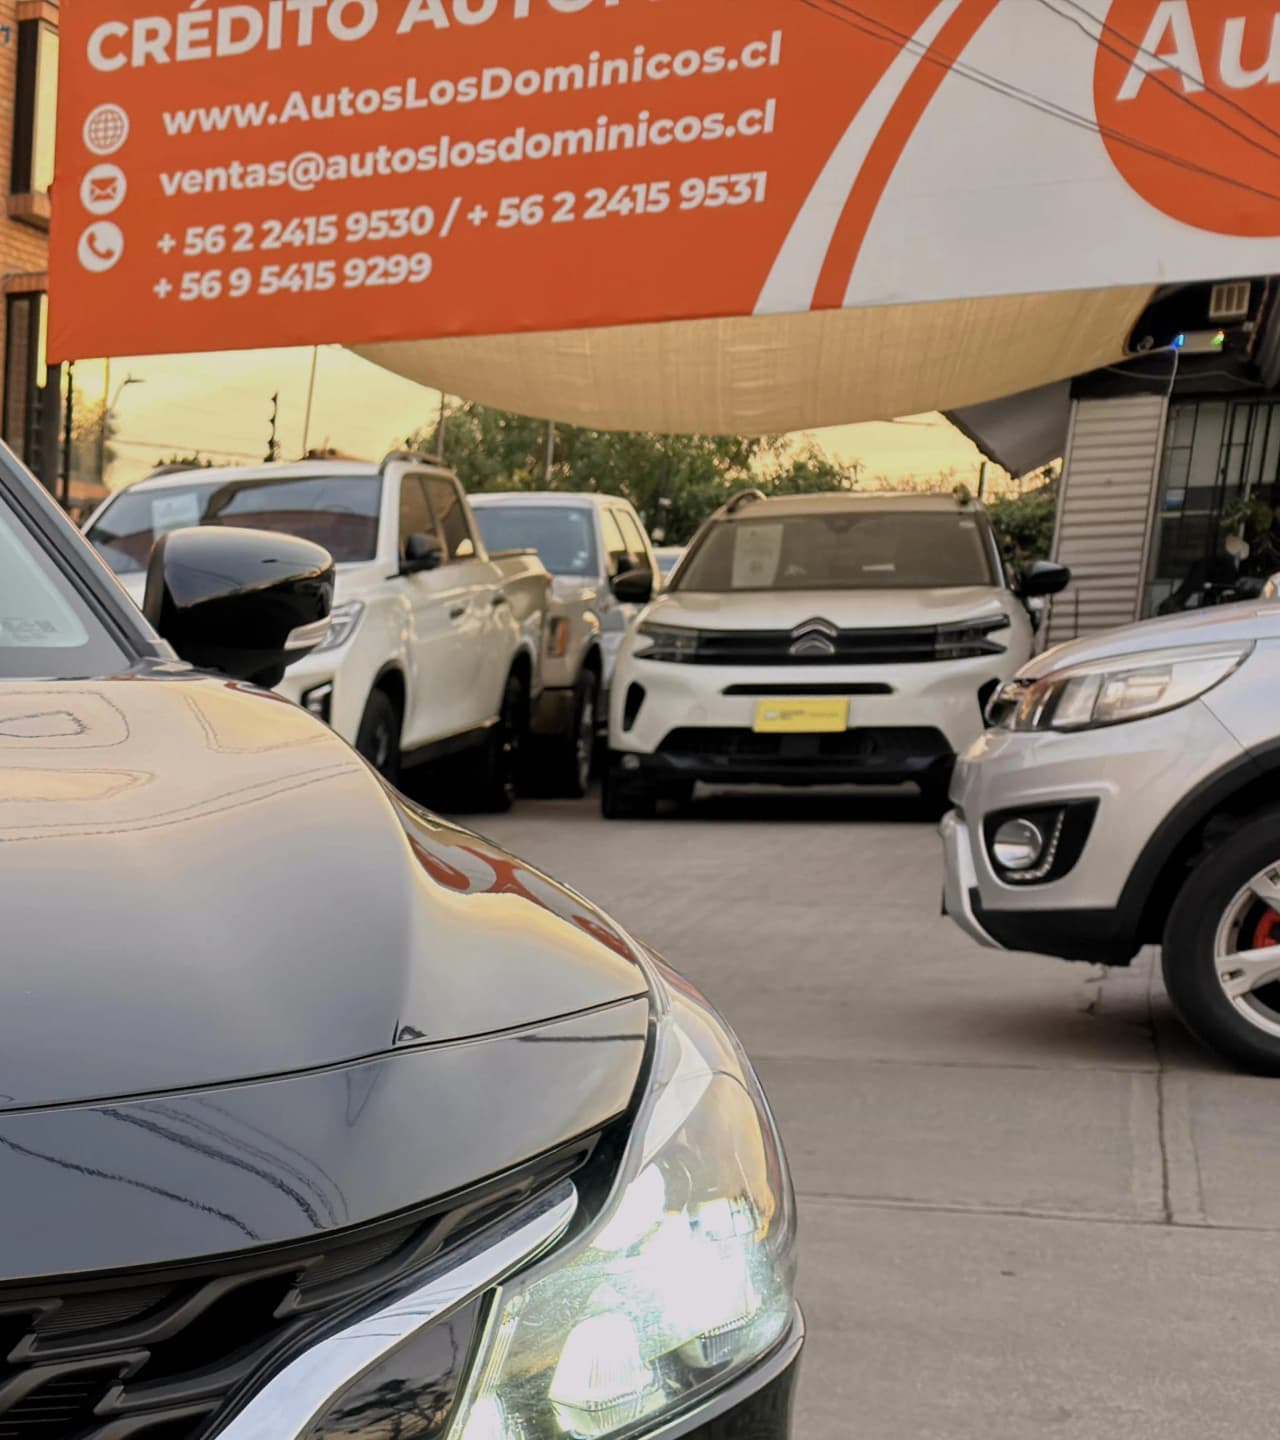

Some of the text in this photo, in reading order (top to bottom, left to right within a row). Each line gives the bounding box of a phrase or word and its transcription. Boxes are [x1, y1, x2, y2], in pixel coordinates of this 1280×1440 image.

[86, 0, 379, 72] CRÉDITO
[162, 30, 782, 136] www.AutosLosDominicos.cl
[159, 98, 777, 196] ventas@autoslosdominicos.cl
[182, 224, 226, 256] 56
[232, 222, 255, 251] 2
[259, 214, 339, 250] 2415
[344, 204, 435, 242] 9530
[496, 194, 545, 229] 56
[551, 191, 576, 223] 2
[583, 181, 671, 219] 2415
[679, 171, 768, 210] 9531
[178, 269, 222, 301] 56
[228, 267, 252, 297] 9
[257, 259, 336, 295] 5415
[342, 251, 433, 288] 9299
